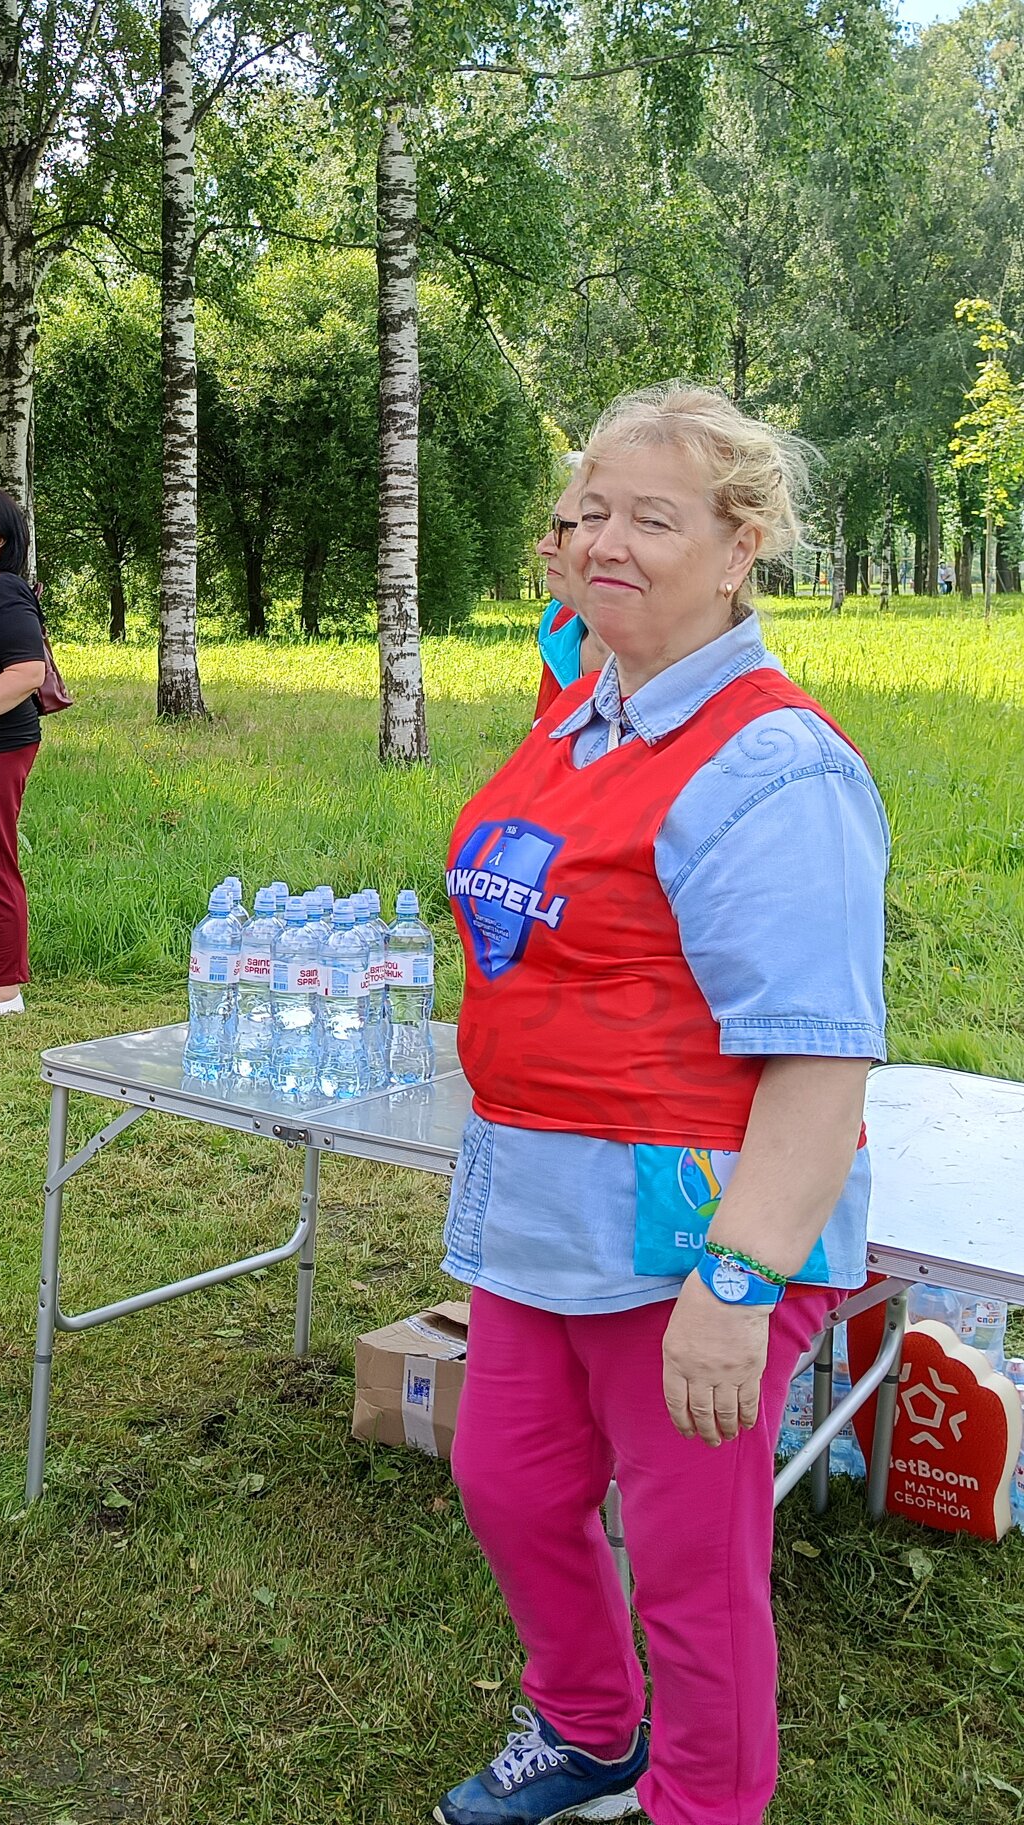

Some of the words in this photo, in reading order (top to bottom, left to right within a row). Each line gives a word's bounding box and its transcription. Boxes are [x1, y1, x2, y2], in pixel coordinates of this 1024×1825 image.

[445, 869, 566, 929] ИЖОРЕЦ
[299, 969, 319, 978] Sain
[904, 1480, 957, 1503] МАТЧИ
[894, 1491, 971, 1520] СБОРНОЙ
